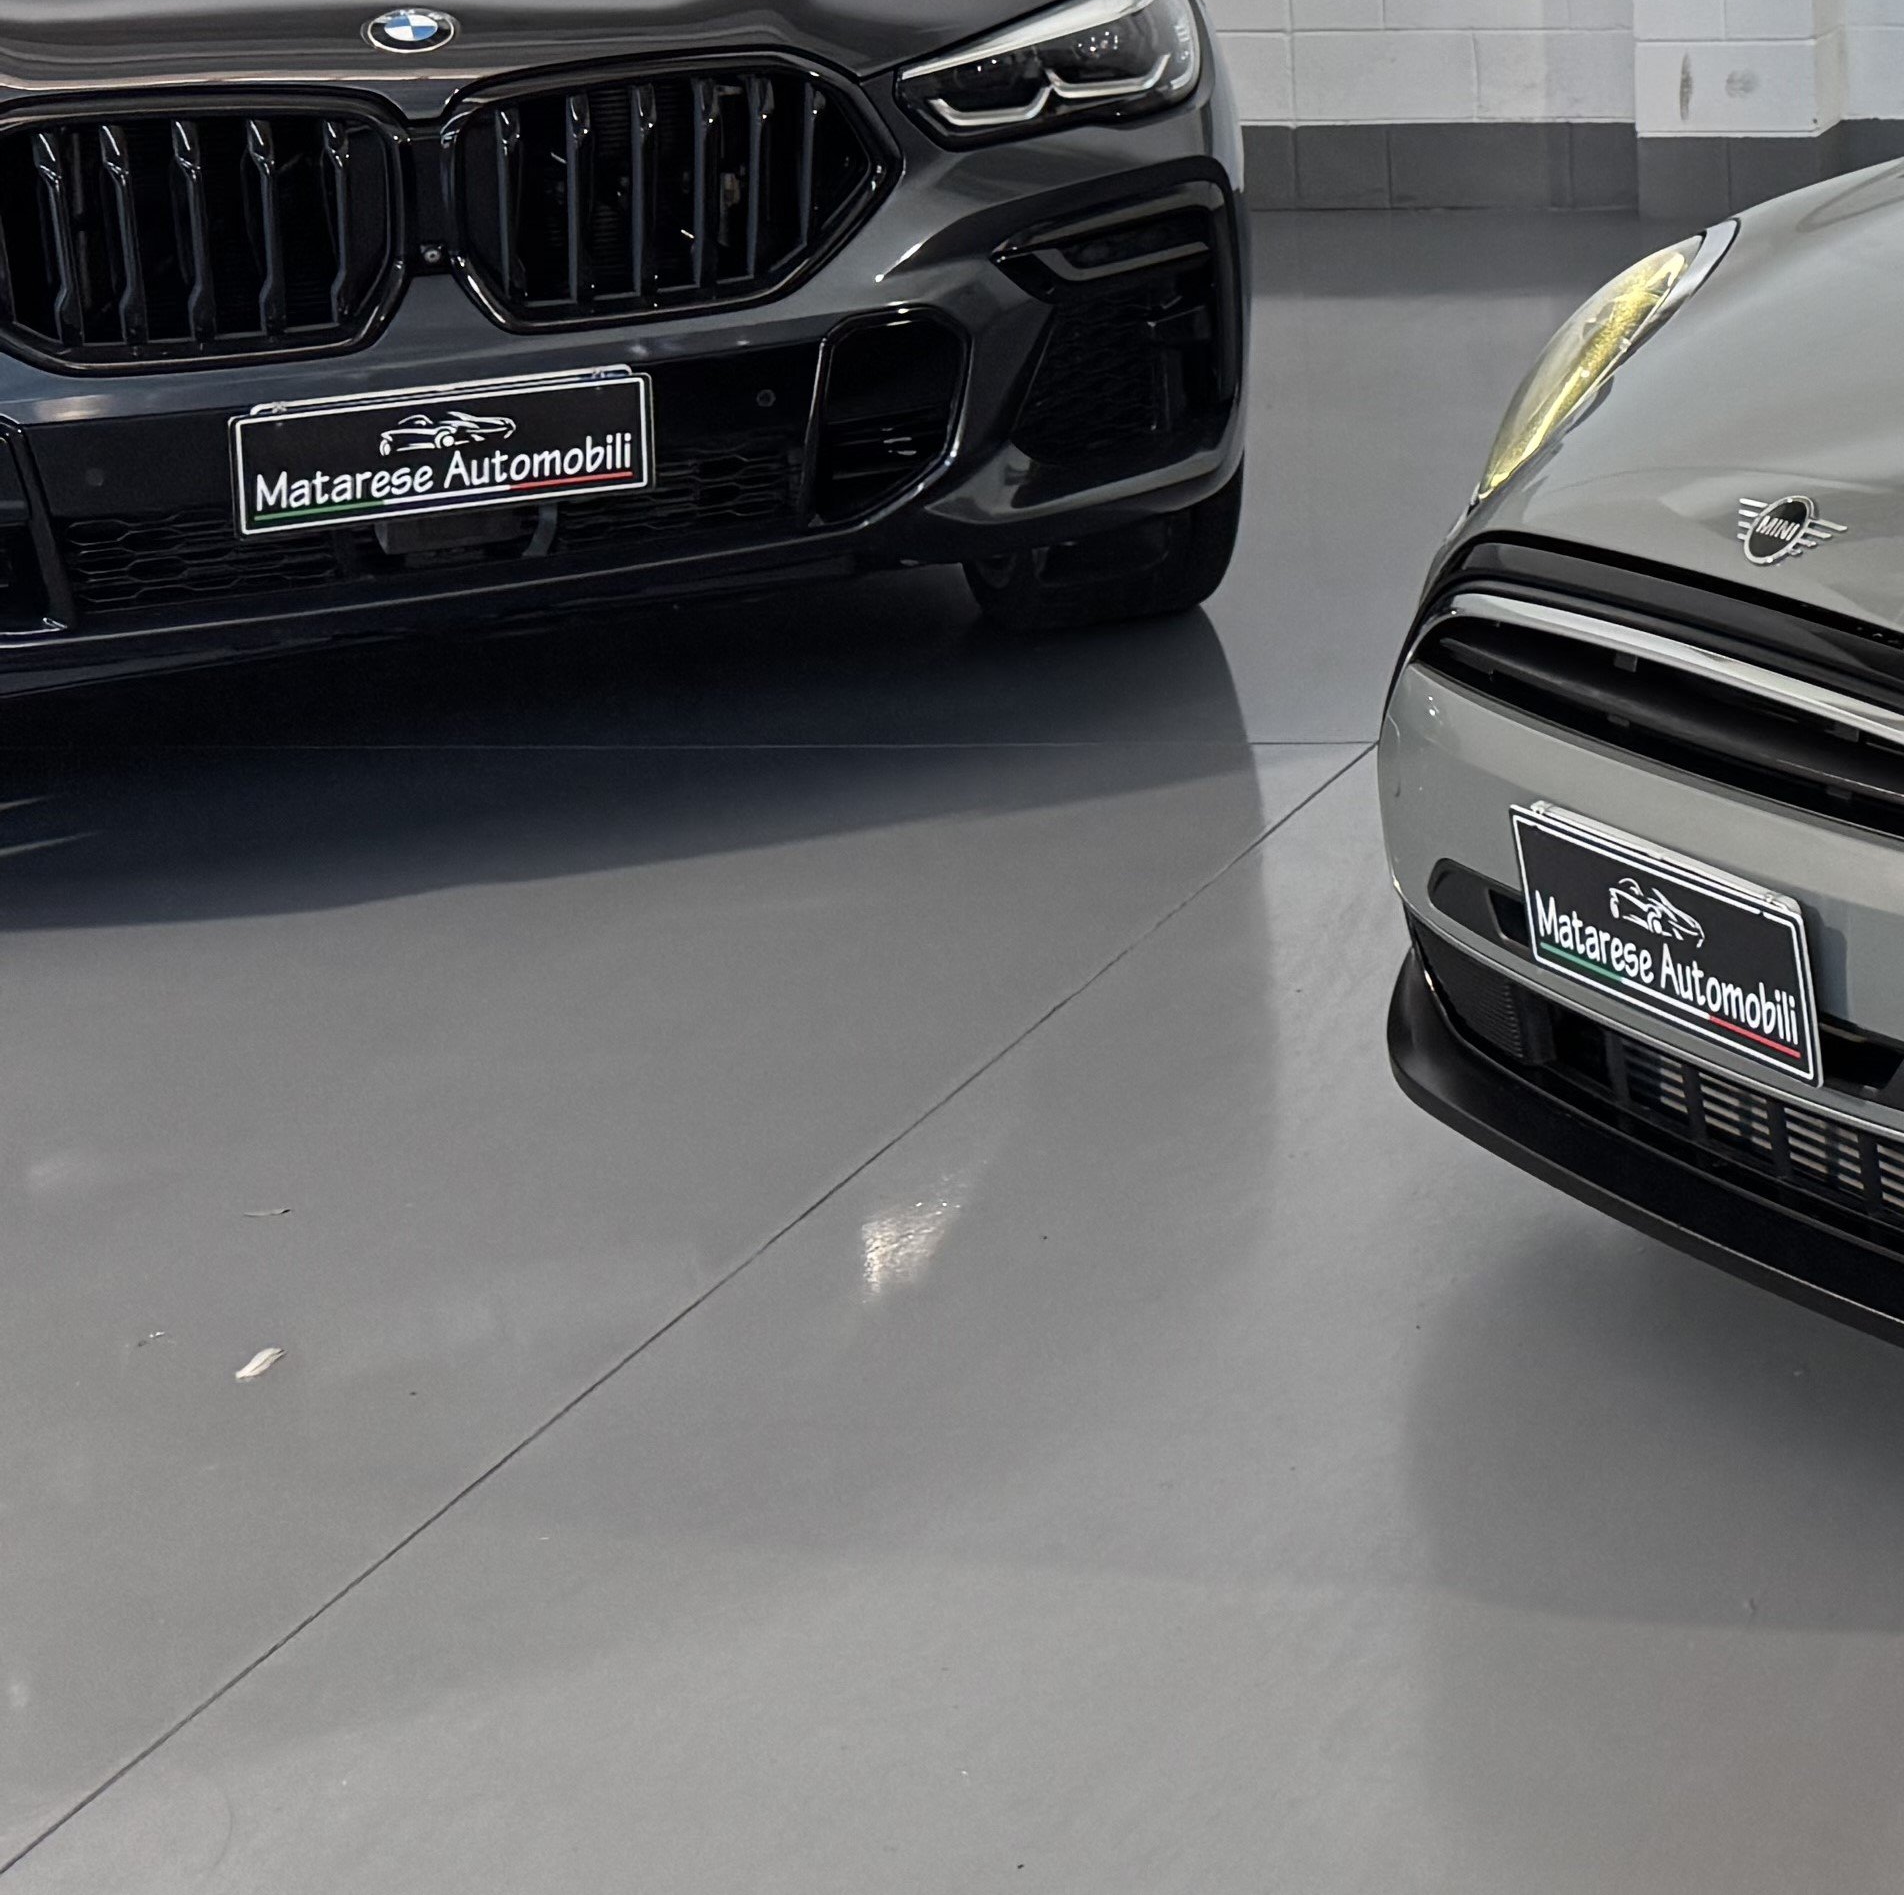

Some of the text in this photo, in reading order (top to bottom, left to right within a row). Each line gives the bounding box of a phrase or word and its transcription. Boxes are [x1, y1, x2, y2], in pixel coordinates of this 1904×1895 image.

[256, 431, 632, 513] Matarese Automobili
[1755, 515, 1801, 542] MINI
[1534, 889, 1799, 1046] Matarese Automobili
